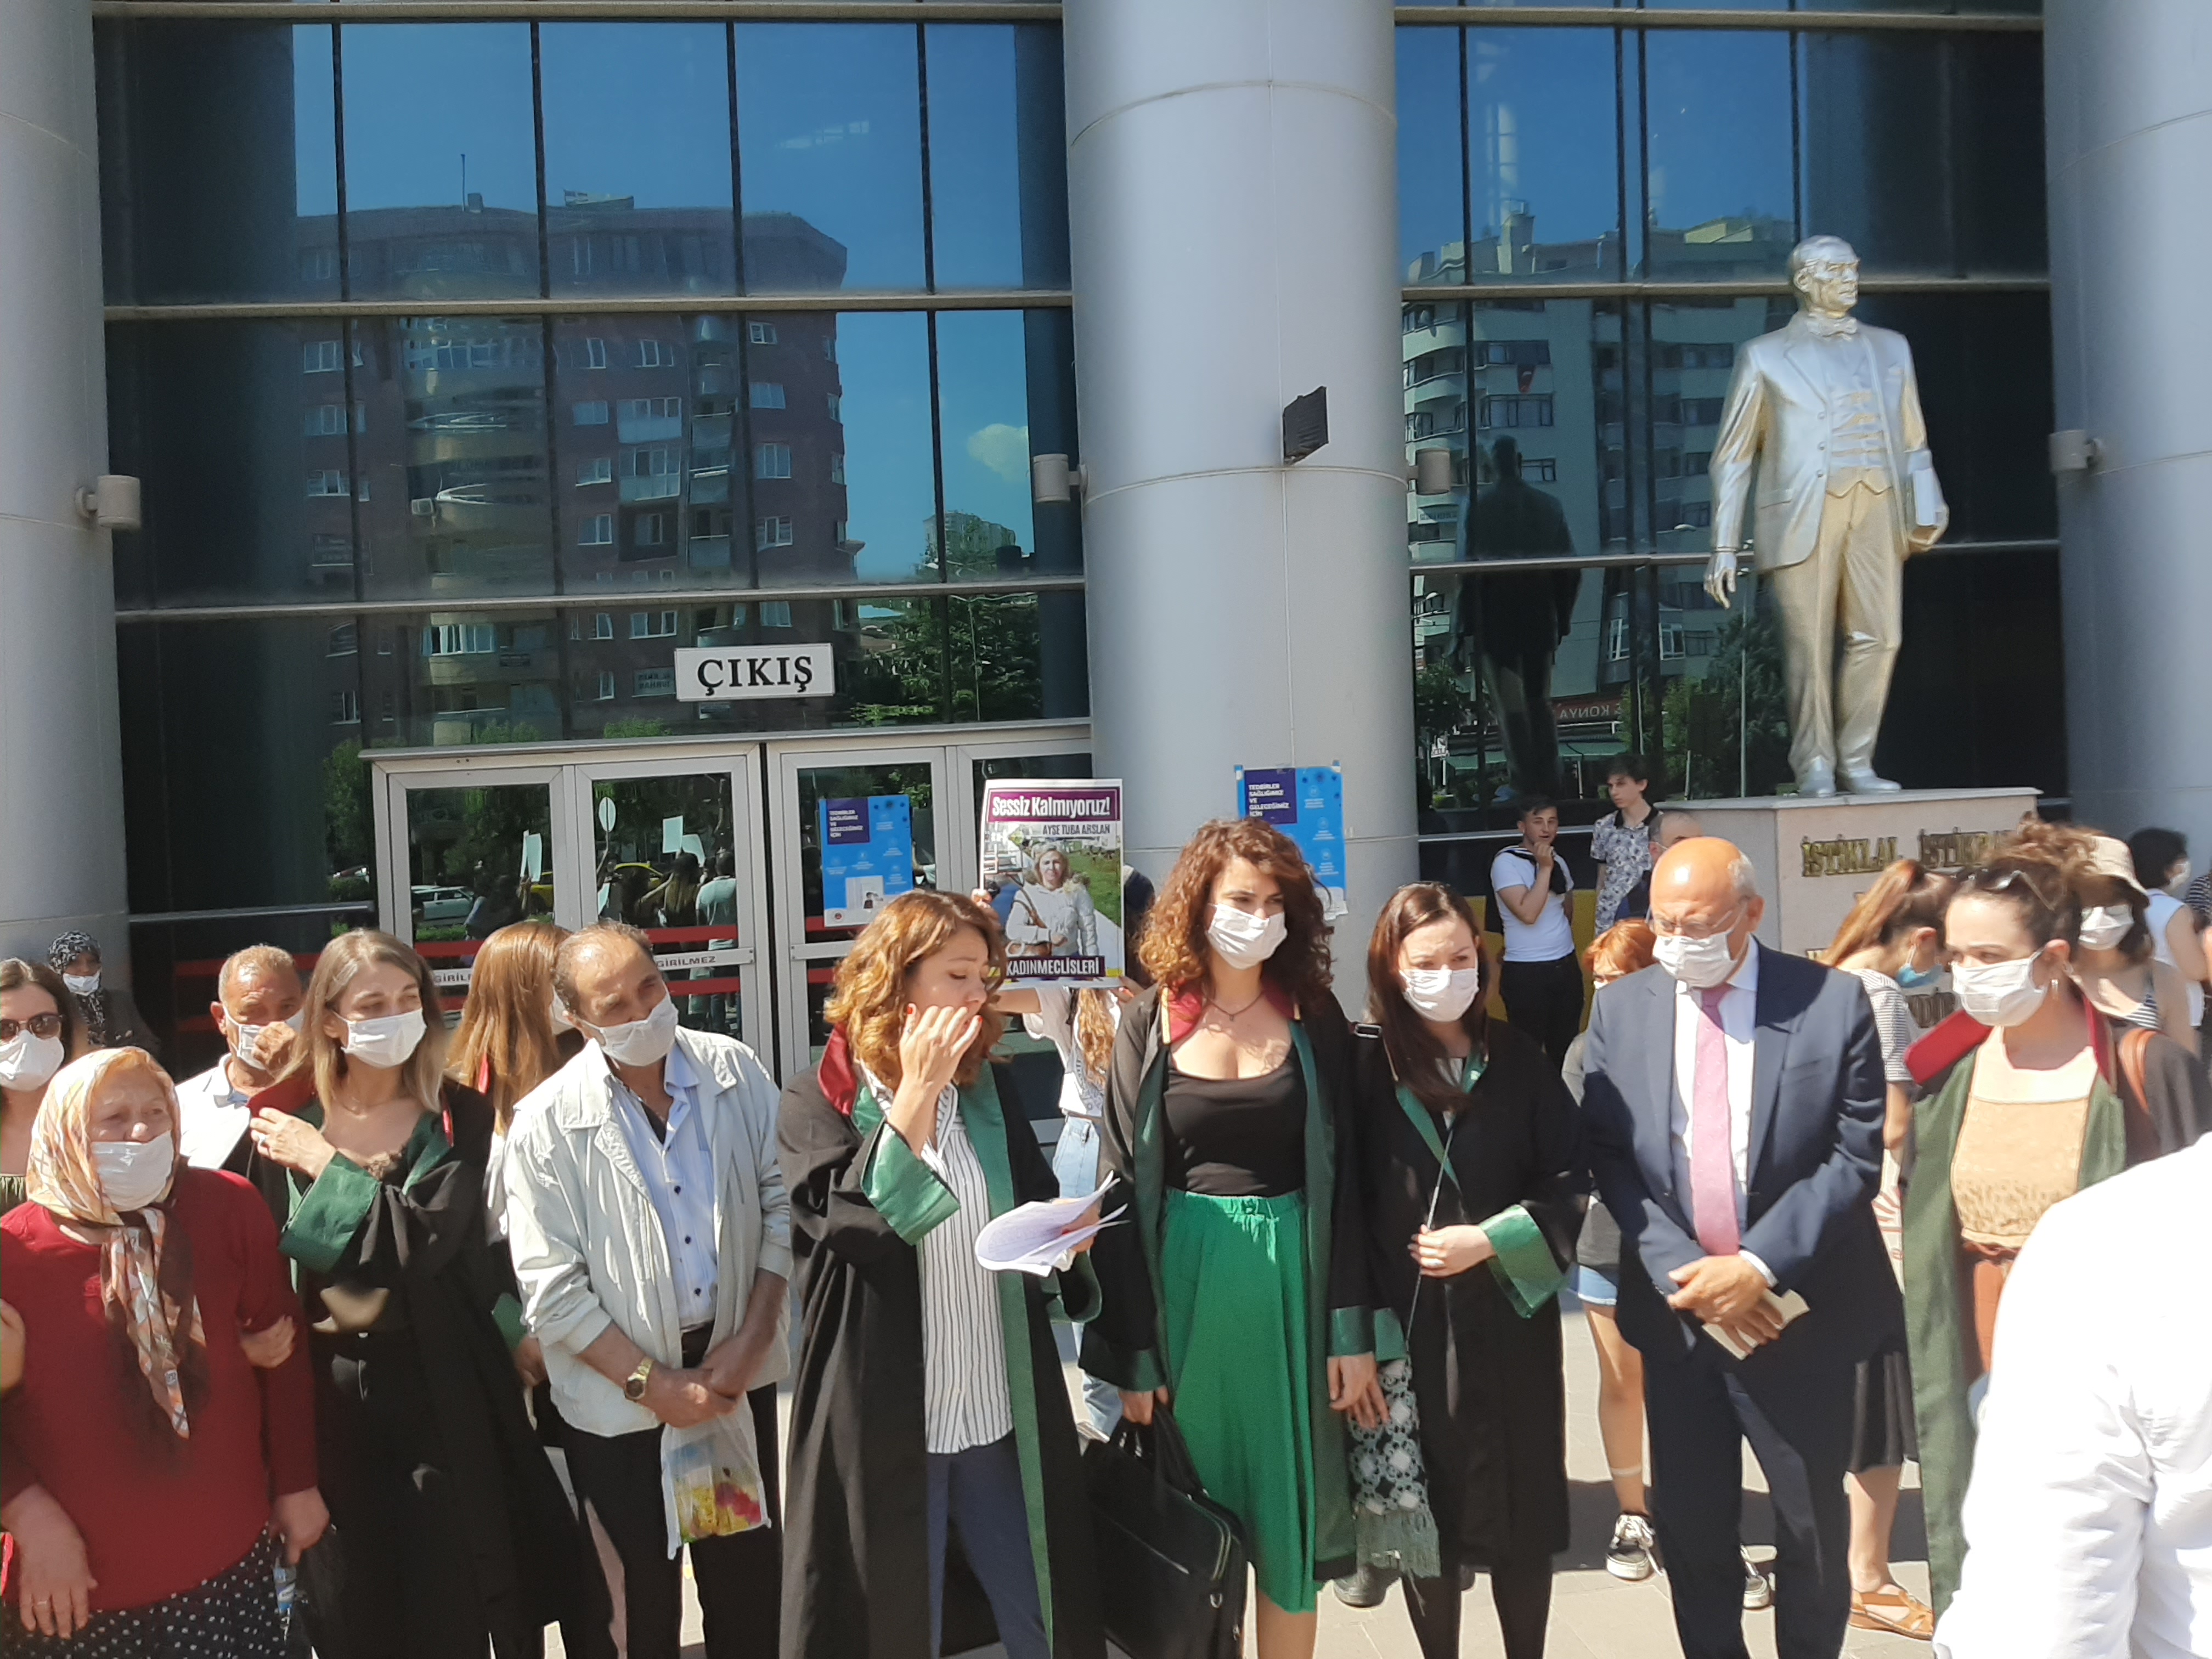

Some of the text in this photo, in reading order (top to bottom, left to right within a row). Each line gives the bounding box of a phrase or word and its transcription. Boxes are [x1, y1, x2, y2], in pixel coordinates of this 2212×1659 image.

[697, 656, 812, 696] ÇIKIŞ
[992, 795, 1110, 819] Sessiz Kalmıyoruz!
[1081, 824, 1110, 834] ARSLAN
[656, 955, 716, 968] GİRİLMEZ
